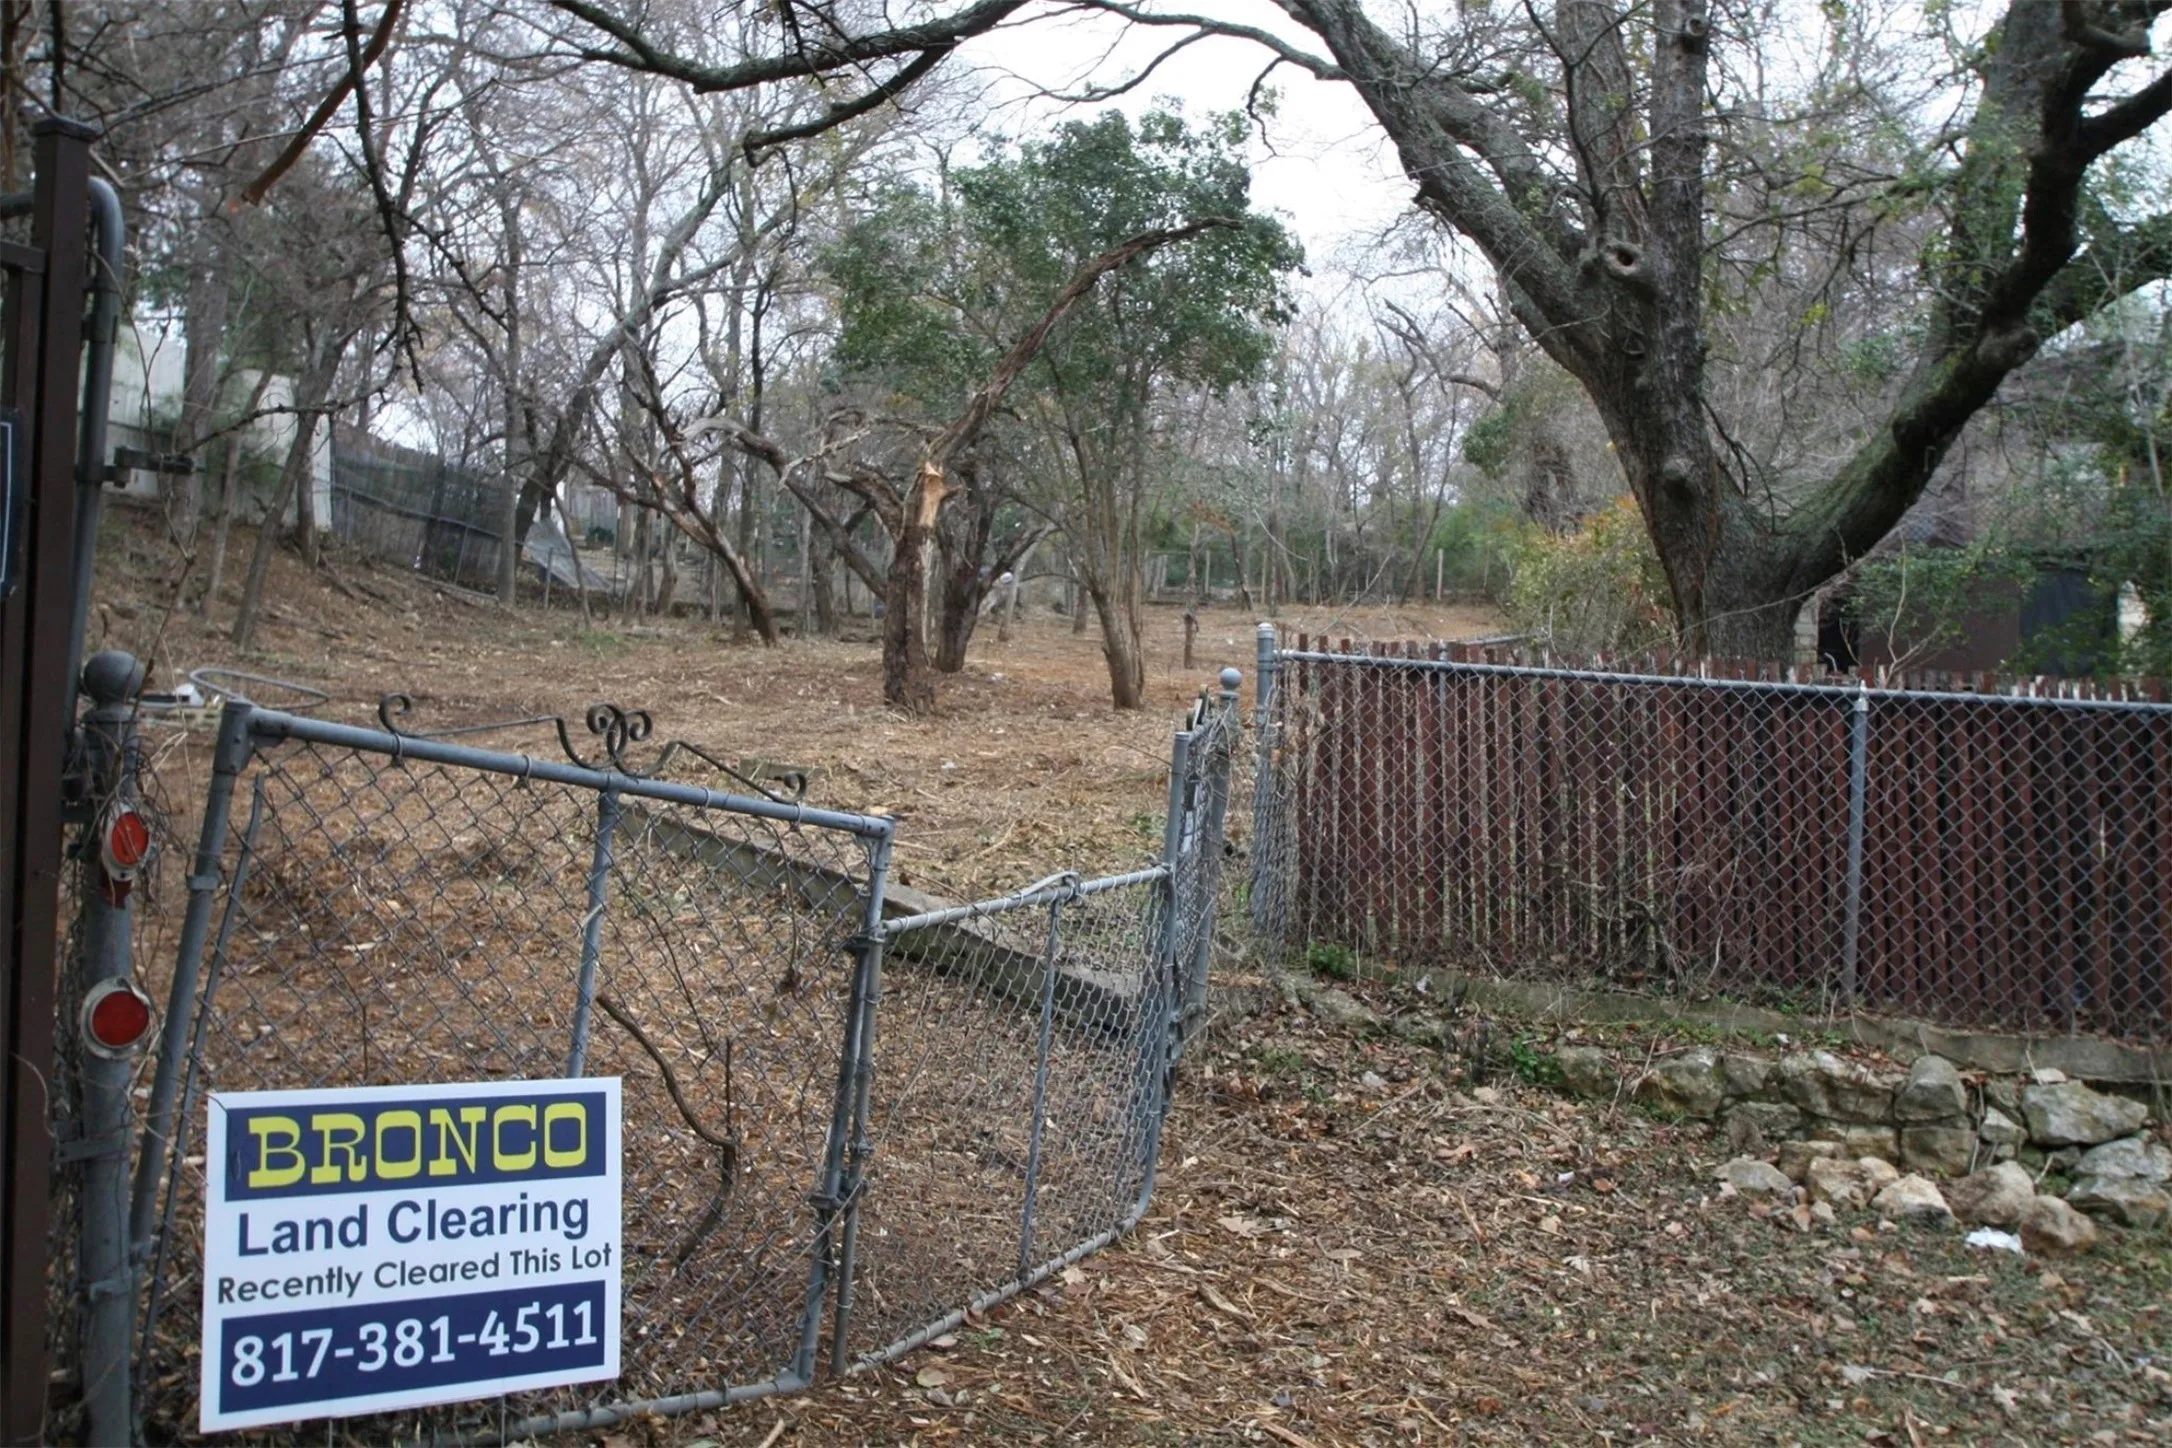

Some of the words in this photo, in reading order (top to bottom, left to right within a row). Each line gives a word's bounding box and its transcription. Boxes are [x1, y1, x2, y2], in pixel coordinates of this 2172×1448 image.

[248, 1102, 587, 1188] BRONCO
[238, 1204, 367, 1257] Land
[388, 1192, 589, 1243] Clearing
[218, 1266, 363, 1304] Recently
[374, 1252, 500, 1289] Cleared
[510, 1247, 561, 1277] This
[572, 1243, 612, 1271] Lot
[231, 1300, 597, 1387] 817-381-4511
